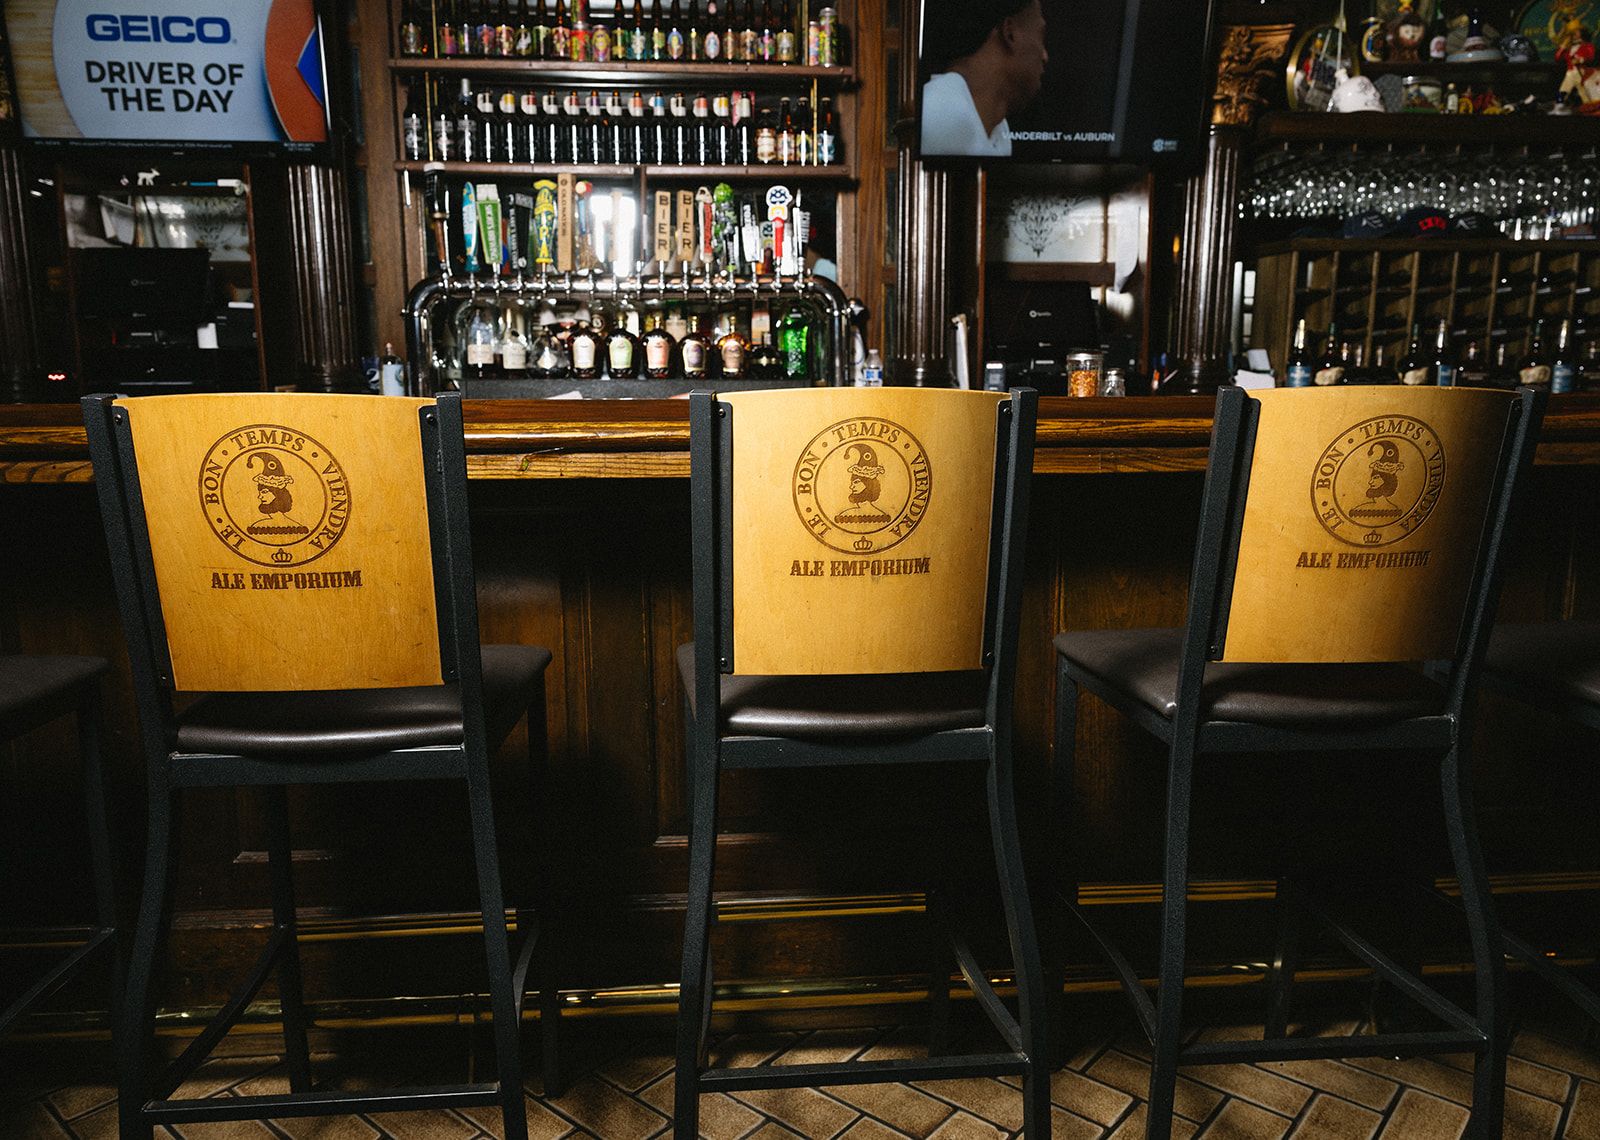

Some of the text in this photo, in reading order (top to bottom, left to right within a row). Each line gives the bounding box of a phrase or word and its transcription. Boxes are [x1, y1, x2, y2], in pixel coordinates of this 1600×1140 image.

[85, 14, 231, 44] GEICO
[84, 60, 244, 86] DRIVER OF
[100, 87, 234, 113] THE DAY
[1001, 131, 1062, 141] VANDERBILT
[1073, 132, 1115, 142] AUBURN
[658, 195, 669, 250] BIER
[682, 194, 692, 249] BIER
[1359, 419, 1425, 440] TEMPS
[798, 422, 929, 539] LE BON TEMPS VIENDRA
[1316, 446, 1345, 490] BON
[204, 429, 347, 550] LE BON TEMPS VIENDRA
[1322, 508, 1345, 532] LE
[790, 557, 931, 577] ALE EMPORIUM
[1296, 550, 1432, 569] ALE EMPORIUM
[211, 570, 363, 590] ALE EMPORIUM
